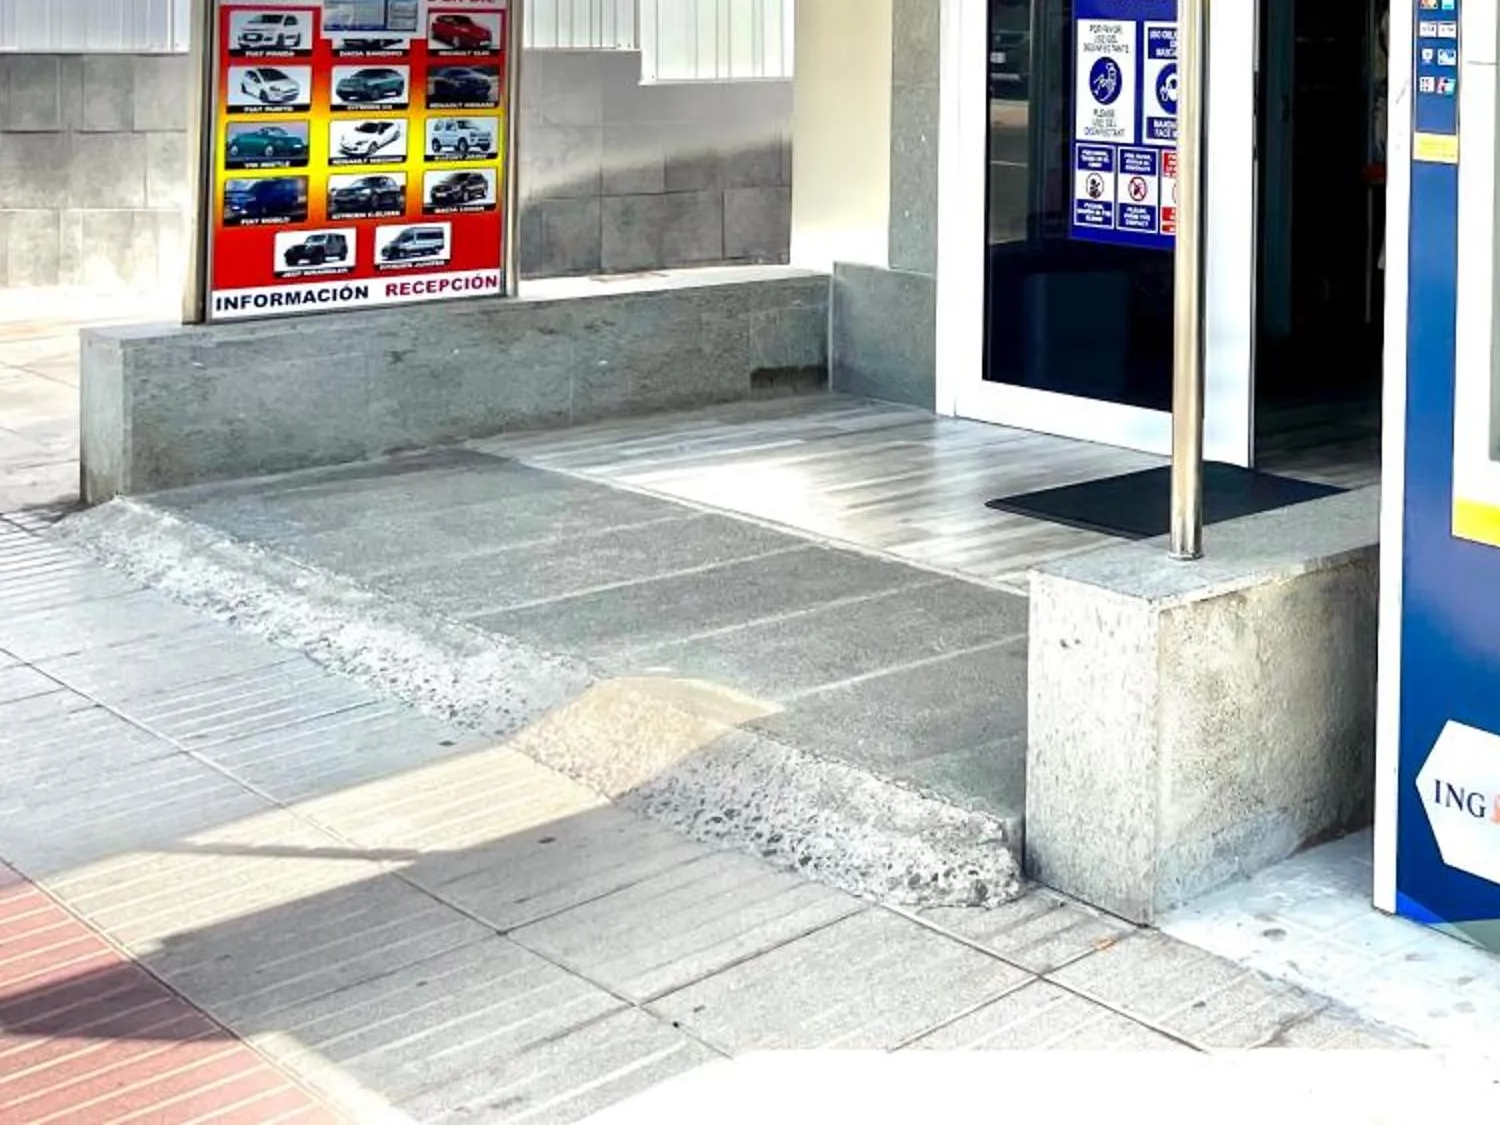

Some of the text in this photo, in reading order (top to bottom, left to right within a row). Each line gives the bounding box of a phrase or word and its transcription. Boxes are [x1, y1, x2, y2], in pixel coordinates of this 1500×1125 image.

[216, 273, 498, 312] INFORMACIÓN RECEPCIÓN
[1433, 779, 1487, 818] ING
